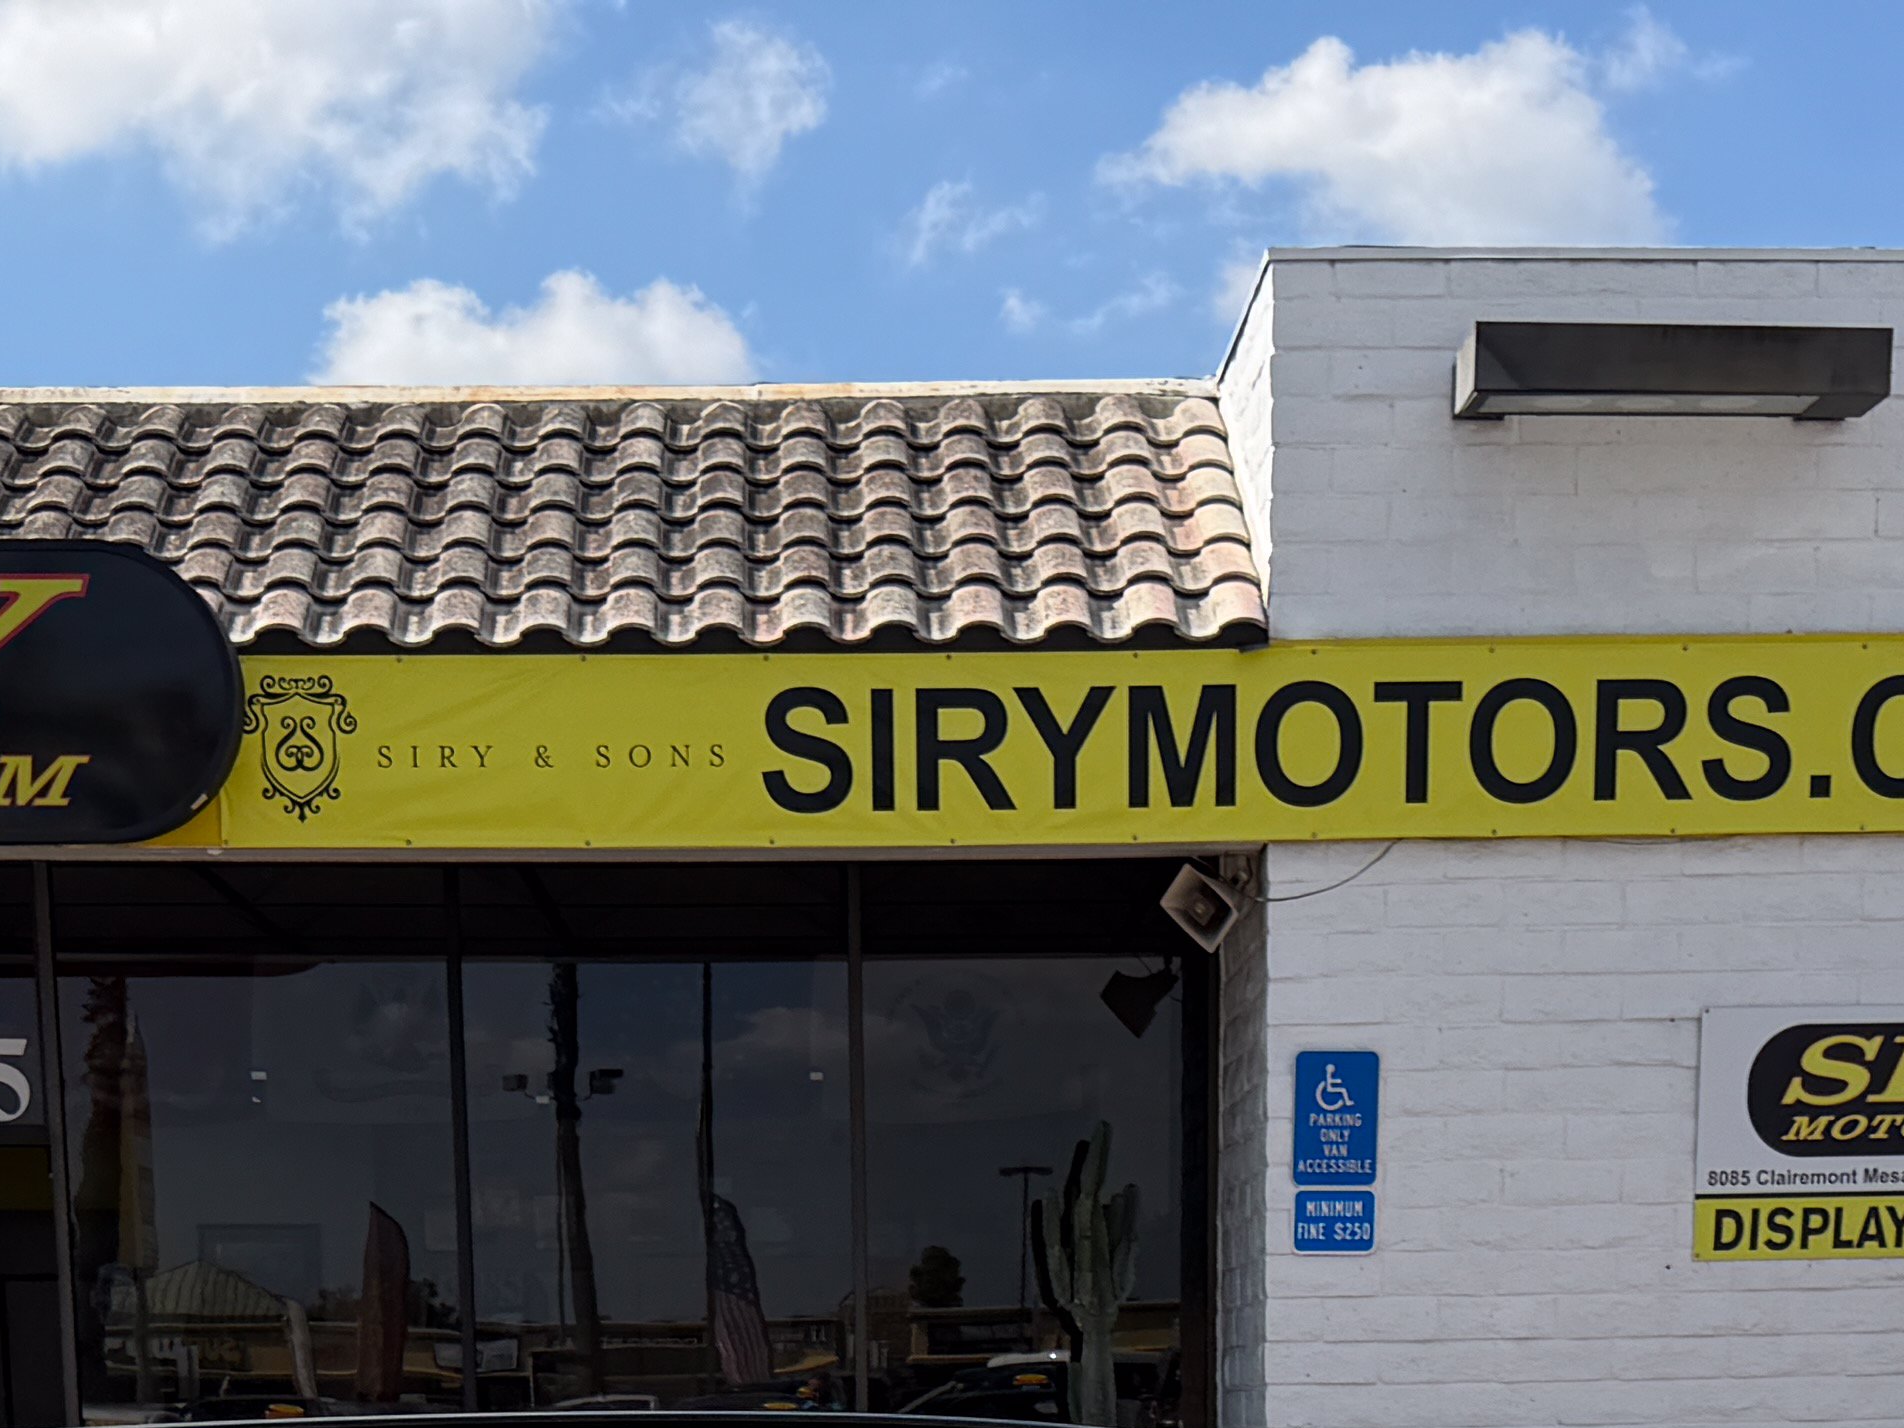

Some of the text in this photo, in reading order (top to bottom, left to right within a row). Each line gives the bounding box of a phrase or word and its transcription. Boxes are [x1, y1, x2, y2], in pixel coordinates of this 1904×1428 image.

[377, 743, 727, 769] SIRY & SONS
[1309, 1114, 1362, 1127] PARKING
[1320, 1129, 1350, 1142] ONLY
[1323, 1145, 1348, 1157] VAN
[1298, 1159, 1372, 1173] ACCESSIBLE
[1708, 1170, 1751, 1187] 8085
[1756, 1167, 1857, 1186] Clairemont
[1306, 1201, 1363, 1216] MINIMUM
[1297, 1223, 1371, 1240] FINE $250
